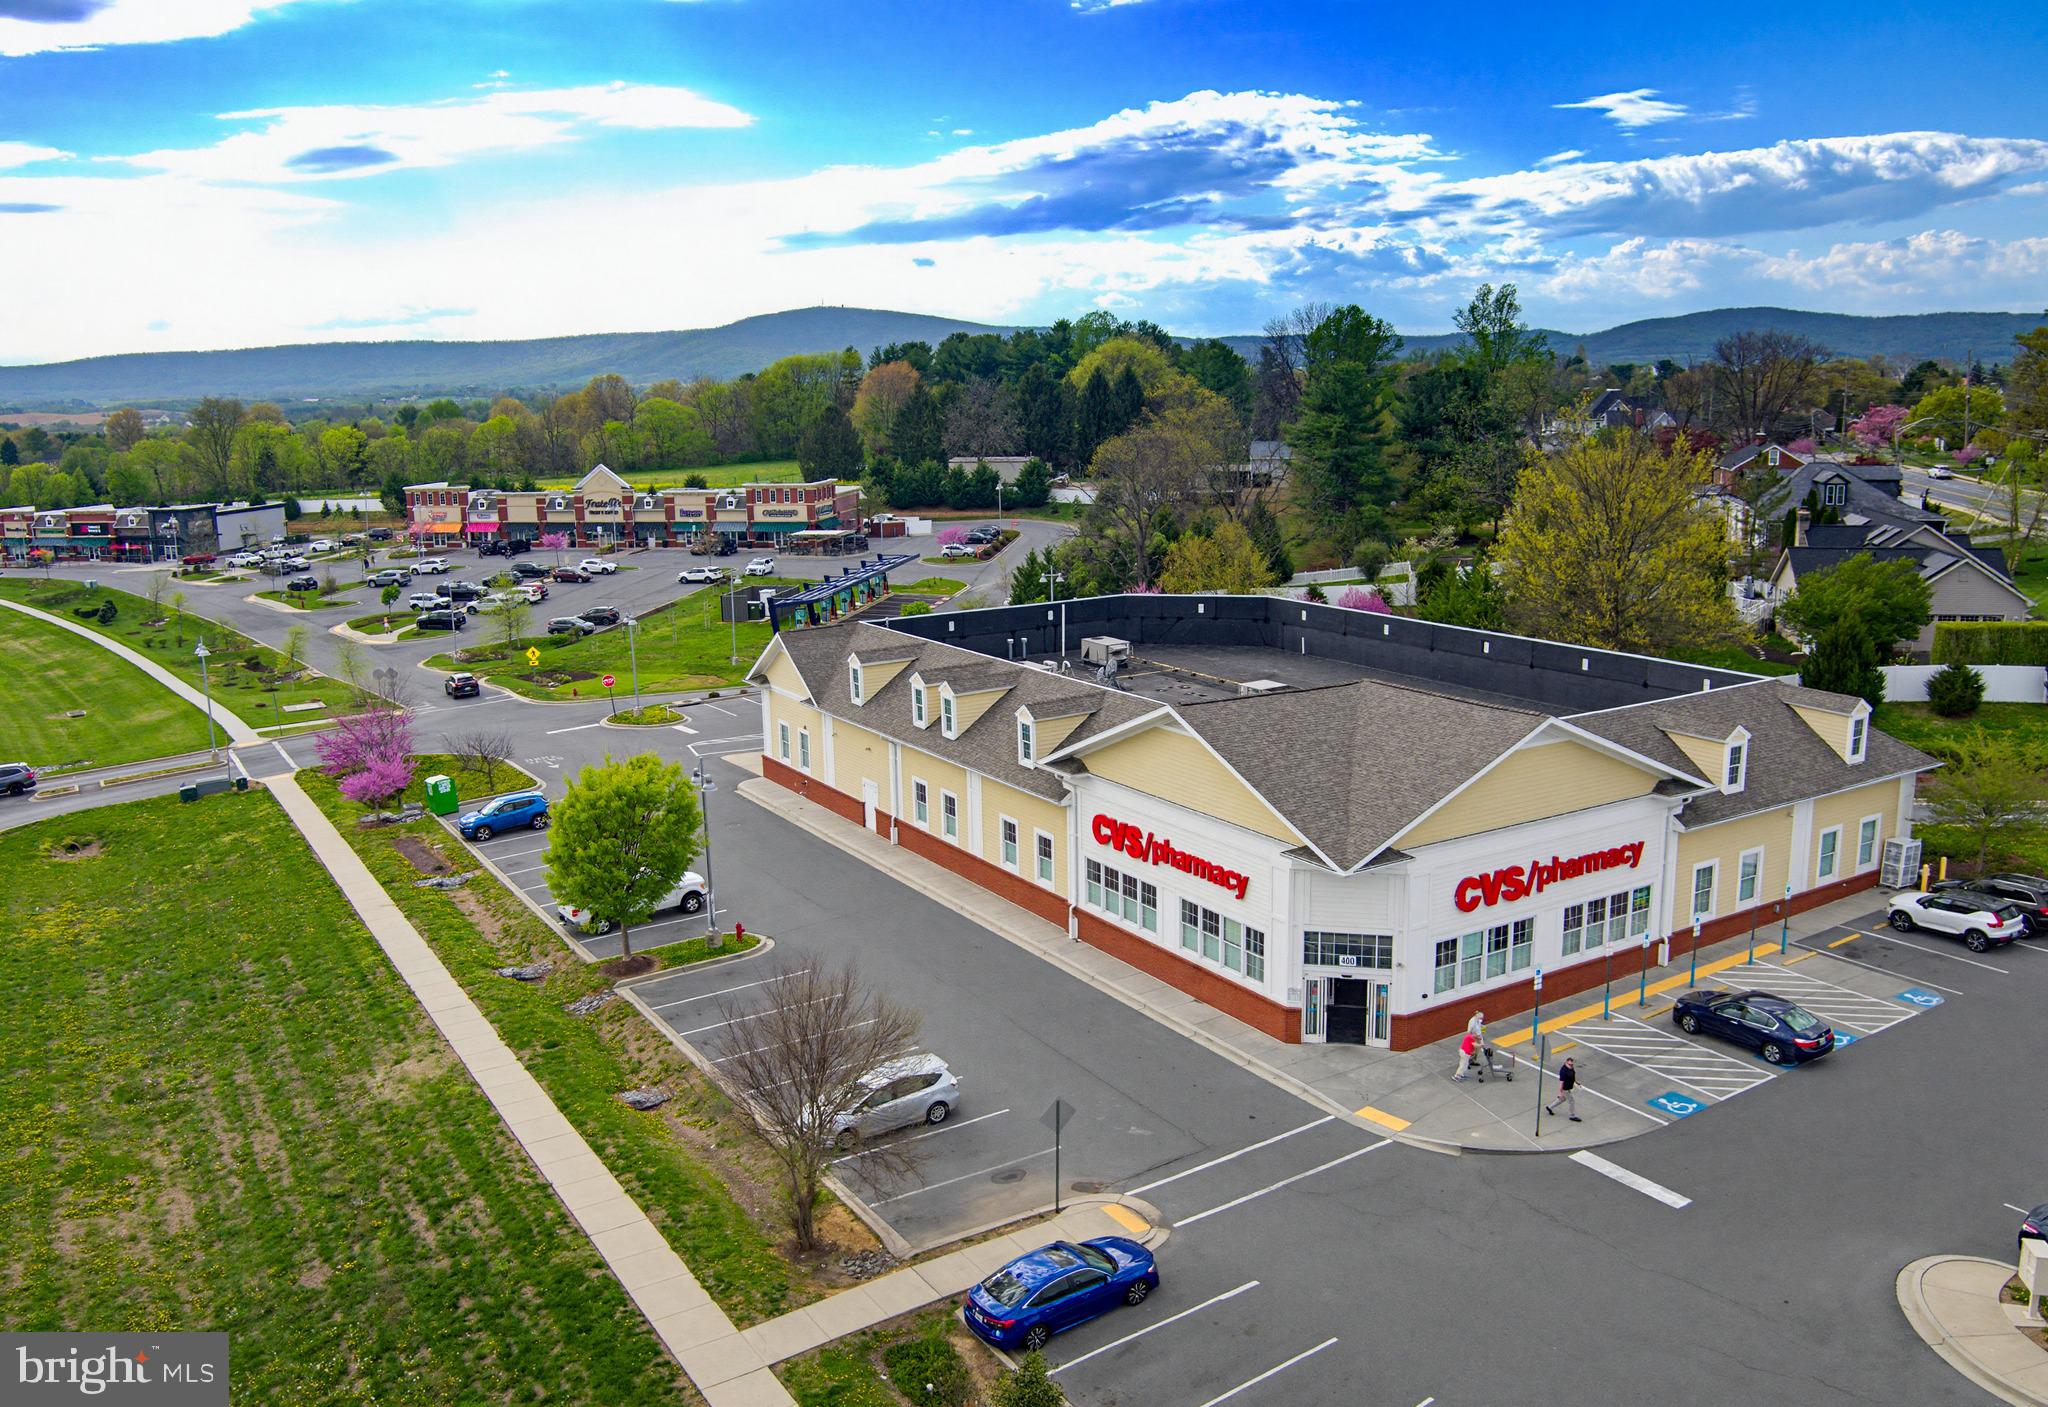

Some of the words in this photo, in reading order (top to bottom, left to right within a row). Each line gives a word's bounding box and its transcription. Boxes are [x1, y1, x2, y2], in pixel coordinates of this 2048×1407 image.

[1091, 813, 1249, 900] CVS/pharmacy
[1455, 840, 1645, 913] CVS/pharmacy
[1341, 956, 1355, 965] 400
